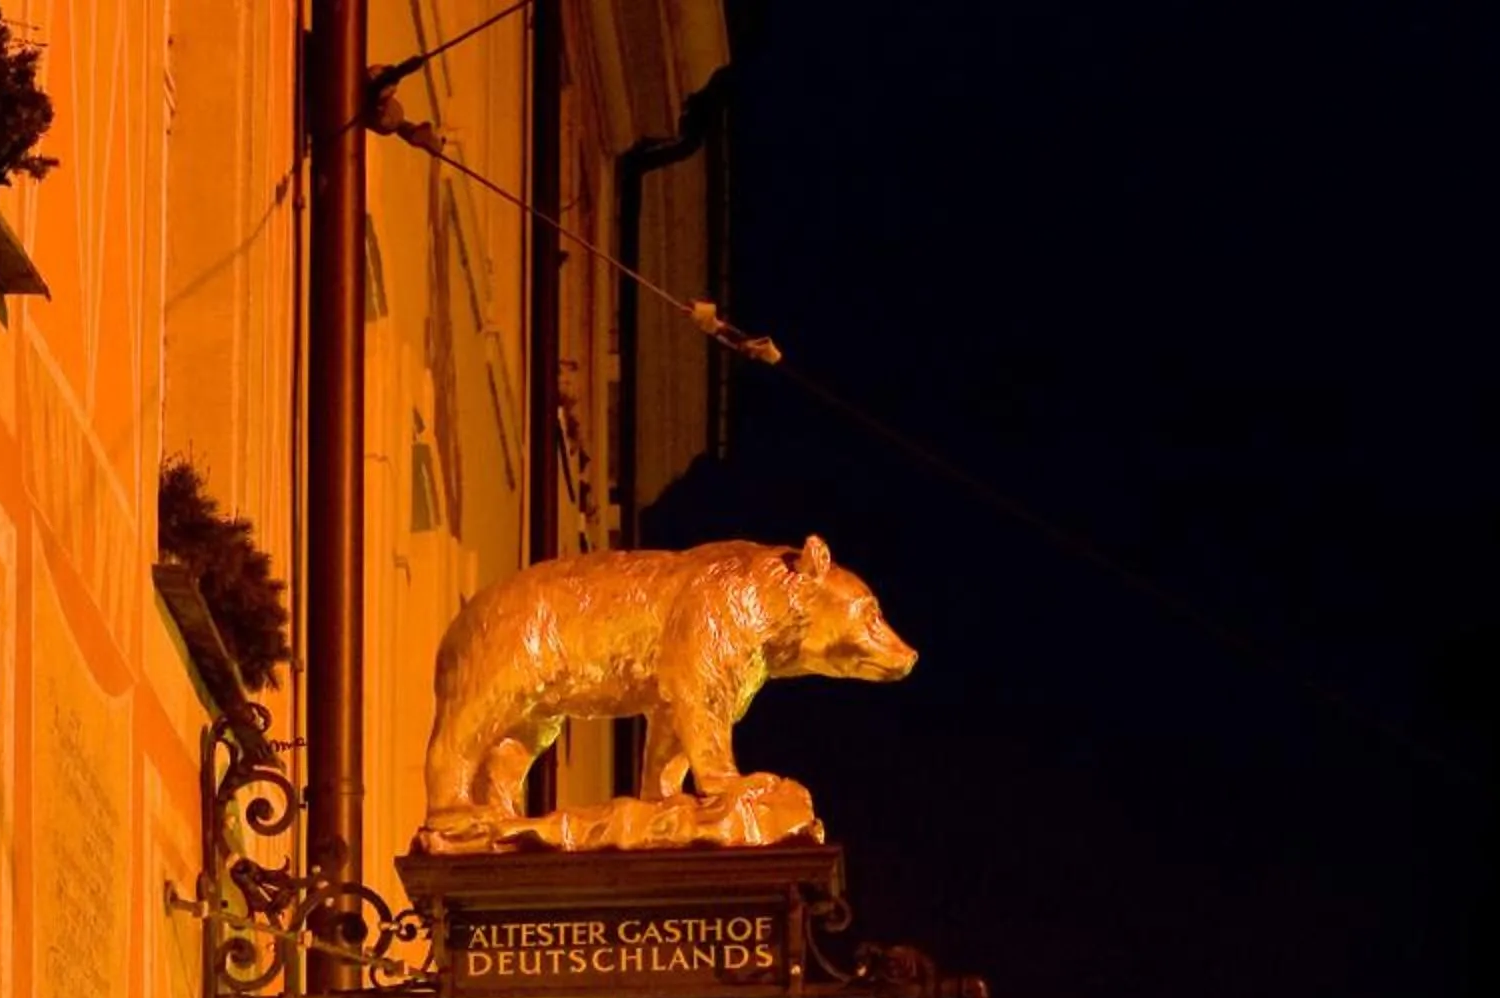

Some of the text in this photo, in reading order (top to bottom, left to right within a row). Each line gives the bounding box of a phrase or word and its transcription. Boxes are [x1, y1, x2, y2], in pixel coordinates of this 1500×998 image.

[468, 916, 773, 949] ÄLTESTER GASTHOF
[467, 944, 774, 977] DEUTSCHLANDS
